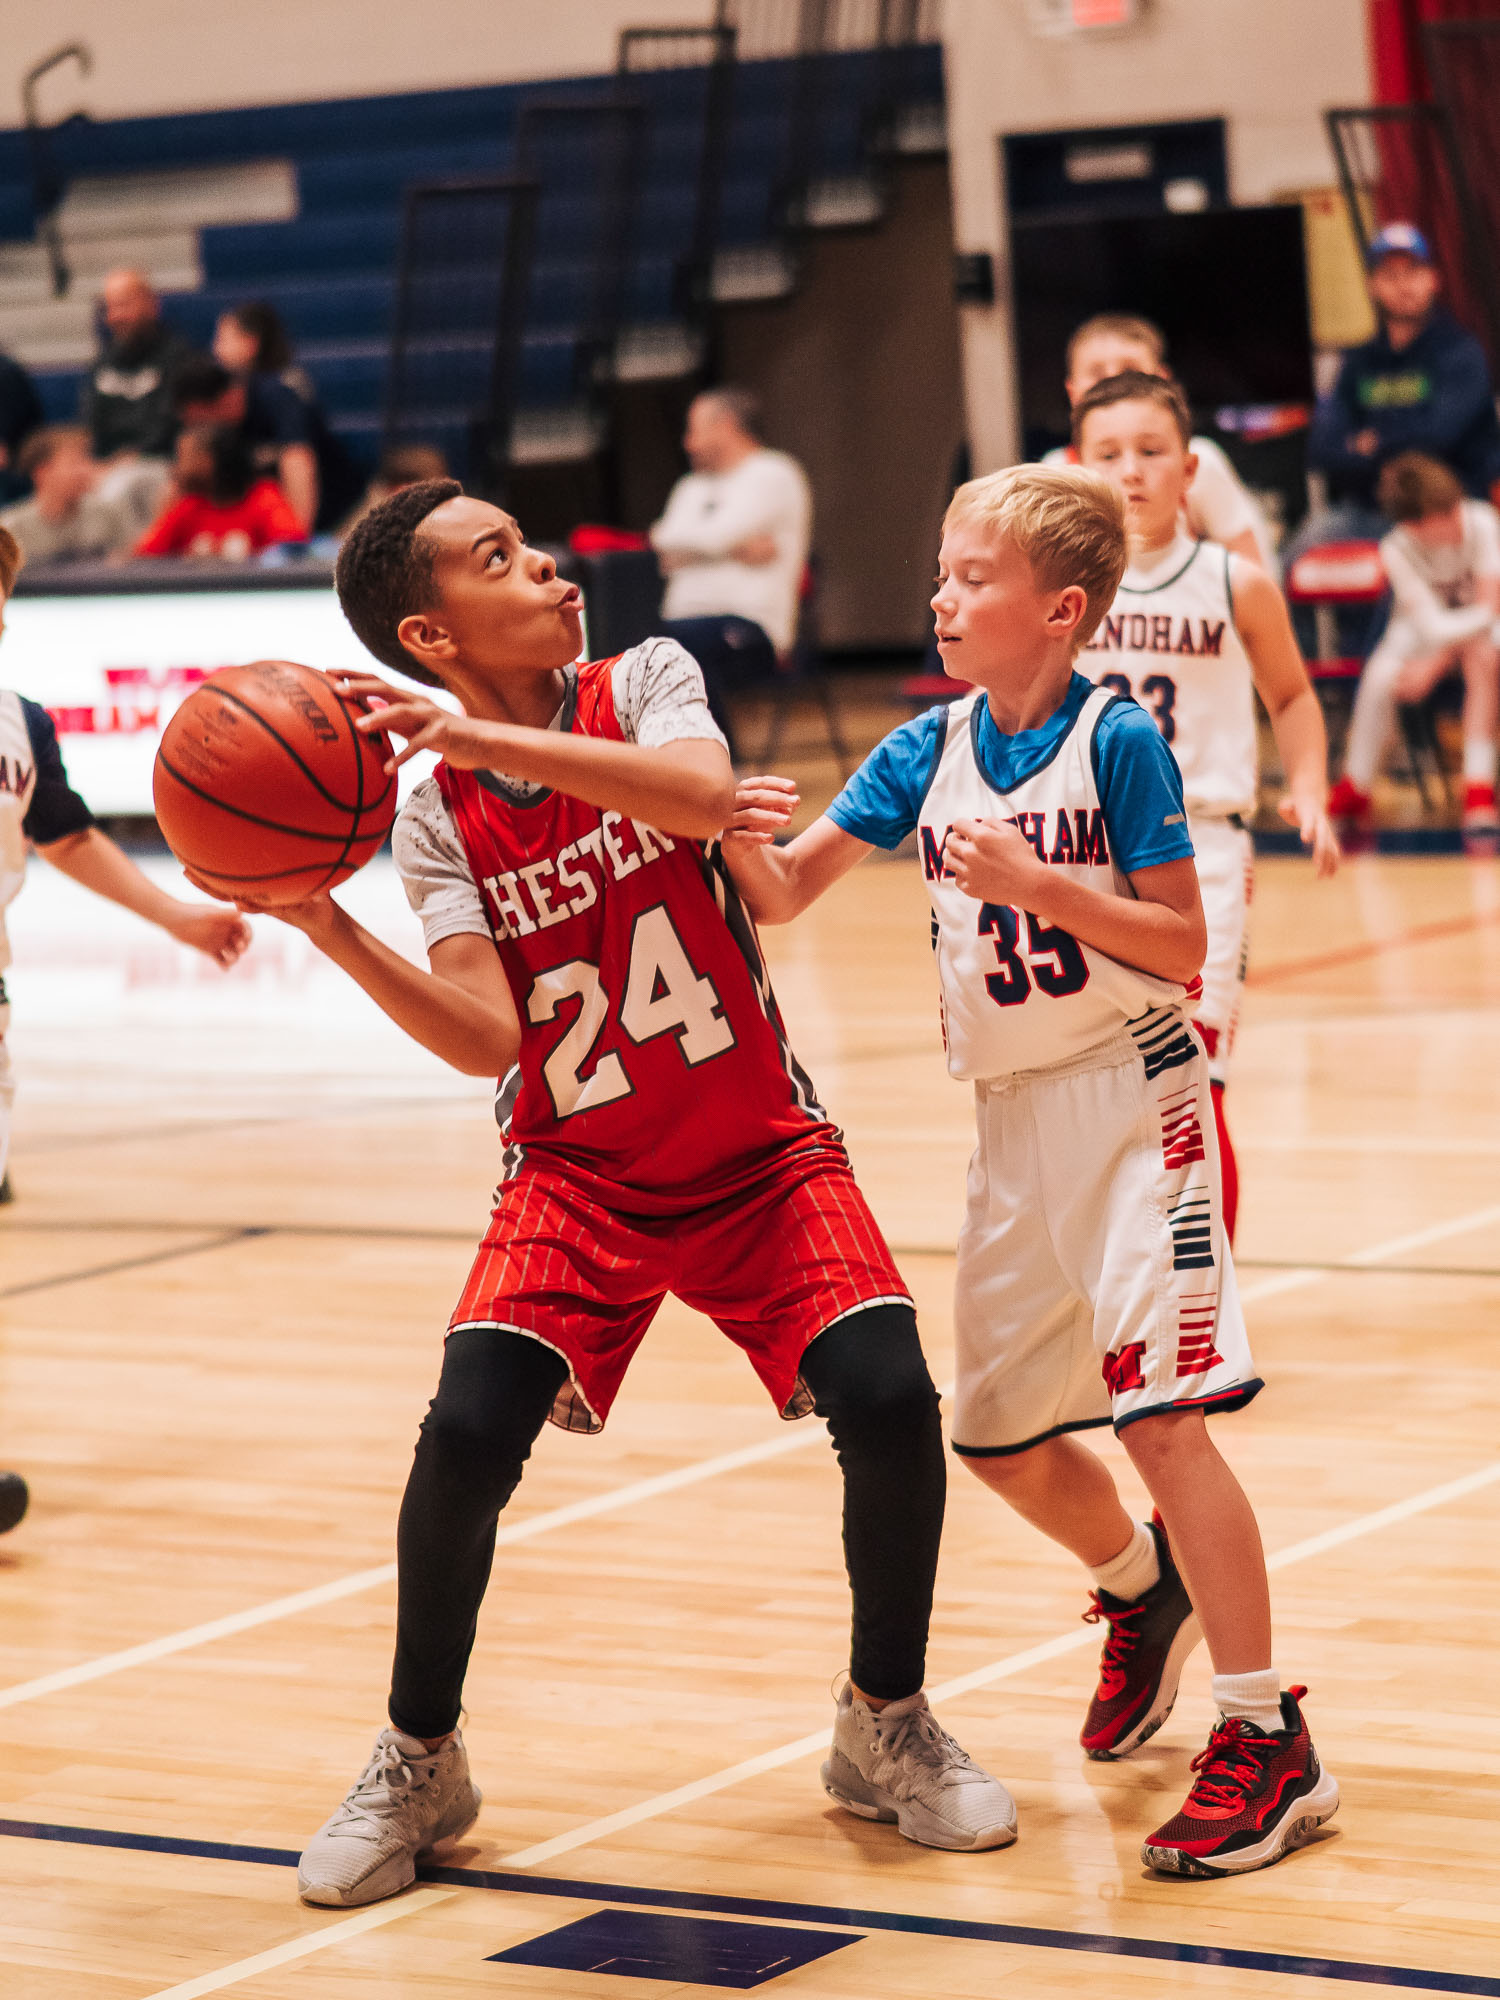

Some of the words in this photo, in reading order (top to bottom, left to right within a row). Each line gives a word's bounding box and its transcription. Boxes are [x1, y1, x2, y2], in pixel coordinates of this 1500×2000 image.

[1084, 614, 1226, 659] NDHAM
[483, 809, 676, 942] HESTER
[920, 807, 1111, 884] MHAM
[977, 903, 1091, 1008] 35
[526, 900, 739, 1122] 24
